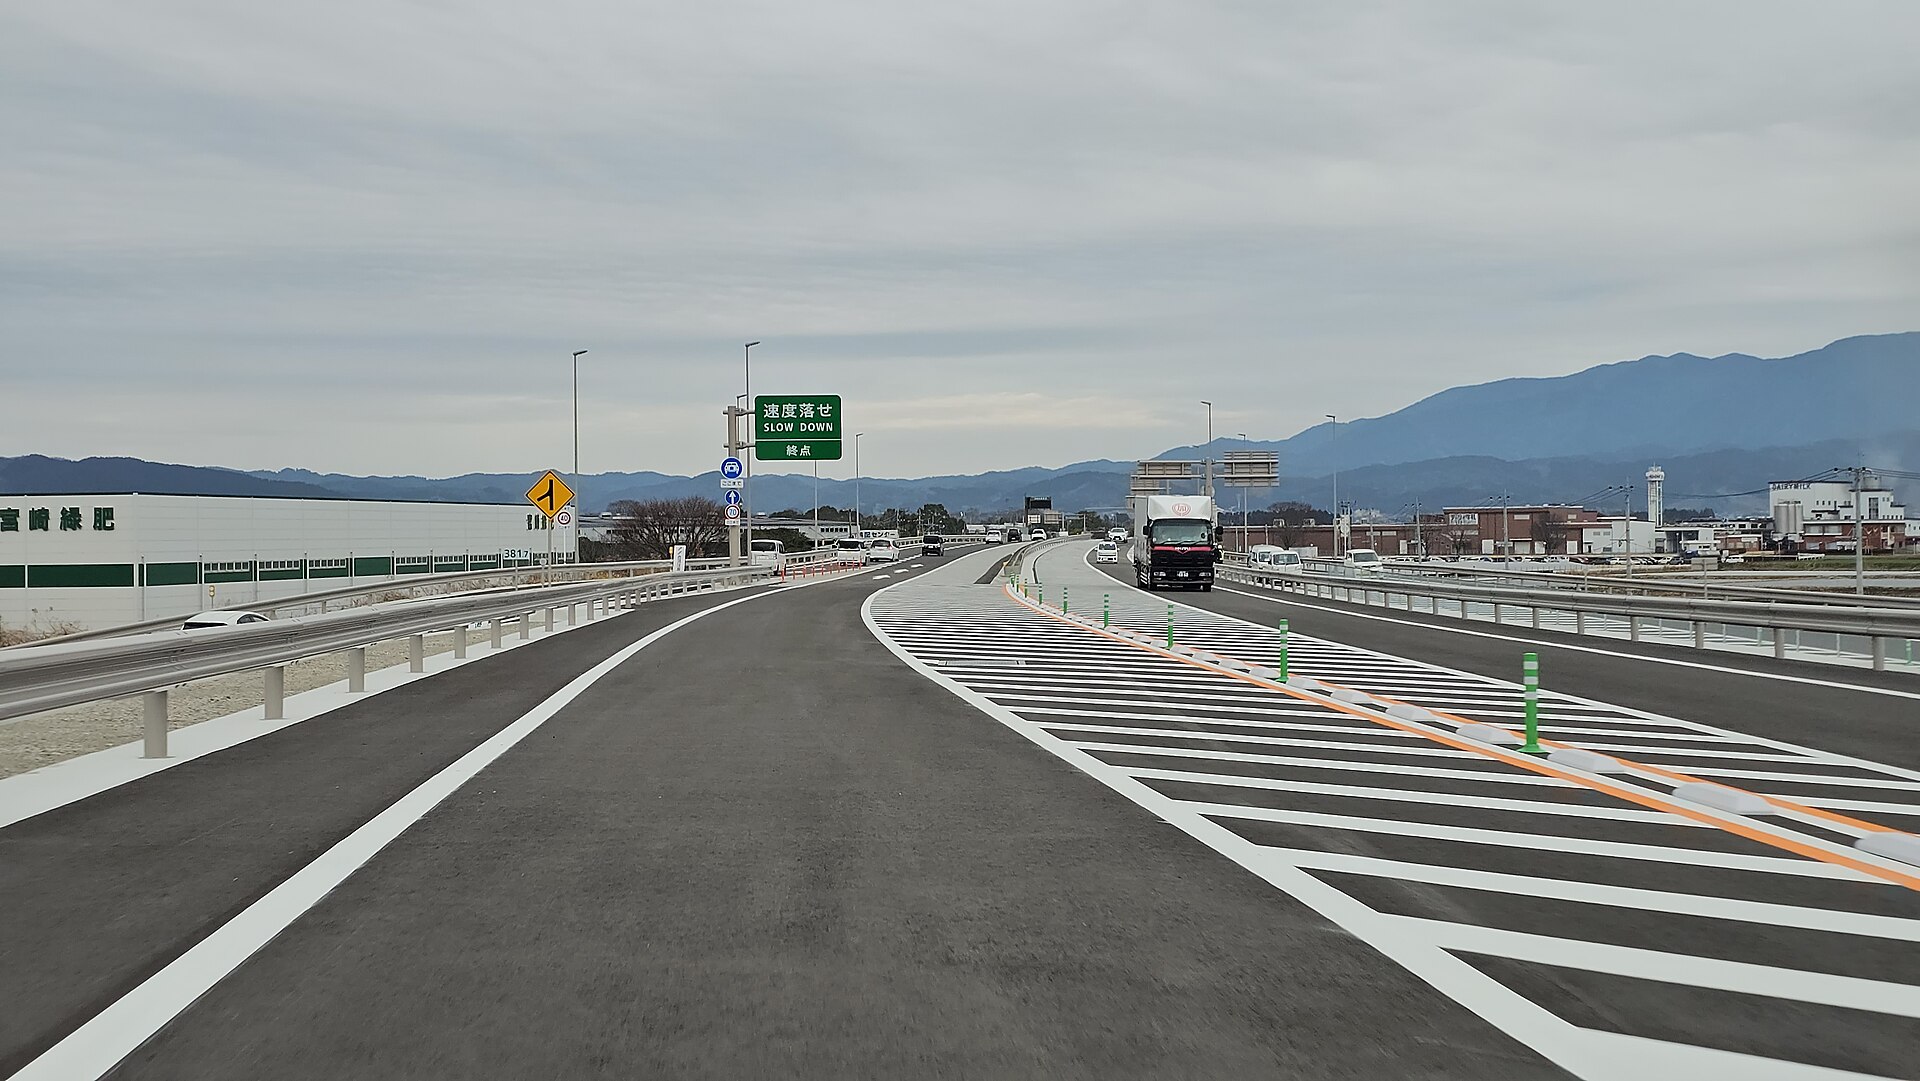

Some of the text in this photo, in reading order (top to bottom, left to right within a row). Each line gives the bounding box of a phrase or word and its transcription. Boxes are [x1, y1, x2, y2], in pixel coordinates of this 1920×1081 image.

[763, 403, 833, 419] 速度落せ
[763, 422, 833, 432] SLOW DOWN
[786, 444, 811, 457] 終点
[0, 506, 116, 532] 宮崎緑肥
